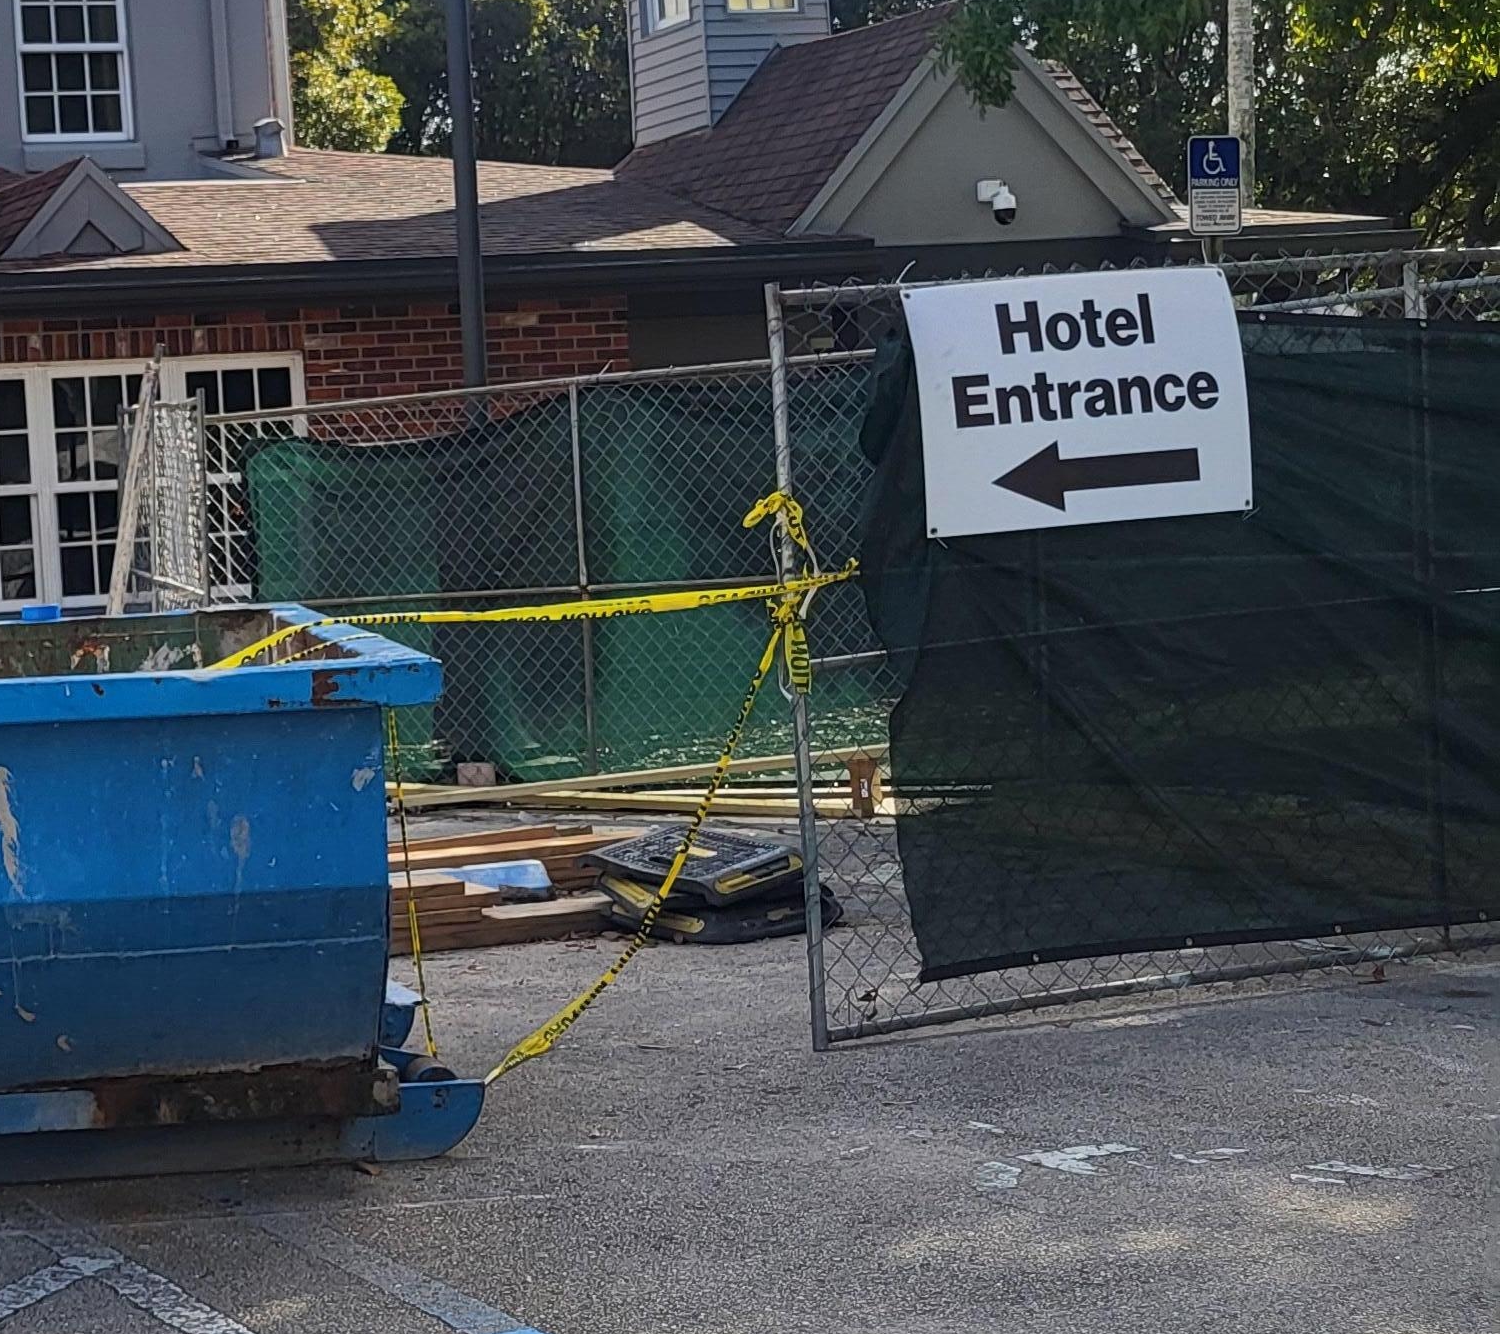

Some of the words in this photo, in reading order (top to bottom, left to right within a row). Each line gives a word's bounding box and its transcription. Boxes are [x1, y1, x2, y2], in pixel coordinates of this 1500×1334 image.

[1191, 178, 1220, 187] PARKING
[1220, 177, 1238, 186] ONLY
[995, 292, 1155, 355] Hotel
[952, 371, 1219, 429] Entrance
